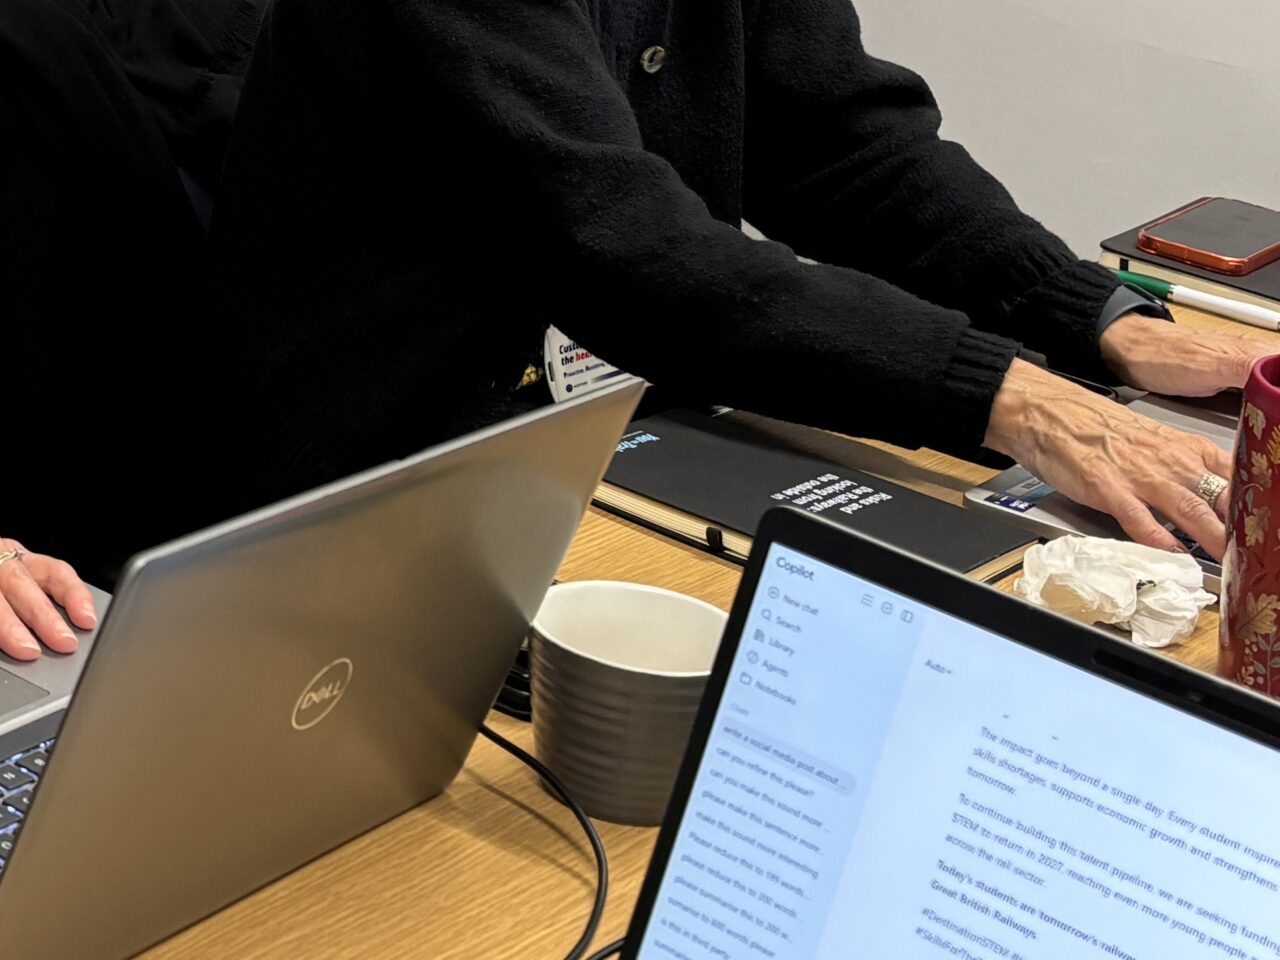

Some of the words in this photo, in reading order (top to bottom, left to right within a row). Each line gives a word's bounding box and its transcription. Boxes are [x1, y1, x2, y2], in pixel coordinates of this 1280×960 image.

[561, 356, 575, 366] the
[782, 480, 821, 496] outside
[812, 480, 858, 495] looking
[816, 473, 840, 482] the
[852, 486, 874, 495] the
[792, 493, 823, 505] from
[839, 503, 863, 514] and
[775, 556, 814, 580] Copilot
[782, 594, 800, 607] New
[801, 604, 818, 615] chat
[775, 616, 801, 632] Search
[768, 637, 794, 656] Library
[761, 659, 788, 677] Agents
[924, 659, 945, 673] Auto
[300, 679, 341, 711] DELL
[755, 680, 796, 705] Notebooks
[716, 747, 730, 757] can
[729, 755, 746, 766] you
[746, 761, 768, 776] refine
[769, 772, 783, 784] this
[723, 726, 742, 738] write
[749, 738, 771, 752] social
[772, 749, 795, 764] media
[795, 760, 814, 773] post
[814, 770, 839, 784] about
[709, 769, 723, 778] can
[722, 776, 739, 787] you
[739, 783, 760, 797] make
[761, 793, 775, 805] this
[776, 801, 801, 817] sound
[801, 813, 822, 828] more
[973, 747, 996, 763] skills
[1050, 783, 1093, 807] supports
[1096, 803, 1146, 831] economic
[1148, 828, 1187, 849] growth
[1190, 846, 1211, 860] and
[981, 726, 997, 741] The
[999, 737, 1033, 757] impact
[1034, 753, 1059, 769] goes
[1060, 763, 1100, 787] beyond
[1101, 783, 1108, 791] a
[1110, 787, 1141, 805] single
[1199, 827, 1240, 849] student
[701, 790, 726, 805] please
[727, 802, 748, 816] make
[749, 812, 762, 824] this
[764, 821, 797, 841] sentence
[688, 831, 712, 848] Please
[712, 845, 738, 862] reduce
[739, 858, 753, 870] this
[754, 865, 763, 876] to
[695, 811, 716, 825] make
[717, 820, 730, 833] this
[731, 829, 756, 845] sound
[756, 842, 776, 856] more
[777, 852, 819, 880] interesting
[945, 834, 975, 853] across
[977, 848, 993, 861] the
[996, 858, 1012, 870] rail
[680, 854, 705, 870] please
[706, 866, 731, 884] reduce
[732, 879, 746, 892] this
[747, 887, 756, 897] to
[959, 792, 969, 805] To
[971, 801, 1013, 825] continue
[1015, 820, 1056, 848] building
[1059, 840, 1077, 856] this
[1079, 850, 1109, 870] talent
[1158, 889, 1173, 900] we
[1176, 897, 1193, 909] are
[1195, 907, 1237, 934] seeking
[673, 875, 699, 891] please
[739, 909, 753, 921] this
[755, 917, 764, 927] to
[930, 879, 957, 899] Great
[959, 893, 990, 915] British
[951, 812, 979, 831] STEM
[980, 827, 991, 838] to
[993, 834, 1023, 853] return
[1025, 848, 1036, 859] in
[1067, 869, 1111, 897] reaching
[1113, 891, 1138, 907] even
[1141, 904, 1169, 922] more
[1171, 919, 1206, 943] young
[1207, 937, 1247, 959] people
[975, 880, 1017, 906] students
[1019, 902, 1036, 914] are
[668, 921, 681, 933] this
[681, 930, 690, 938] in
[700, 913, 710, 923] to
[726, 928, 748, 944] words
[749, 941, 775, 957] please
